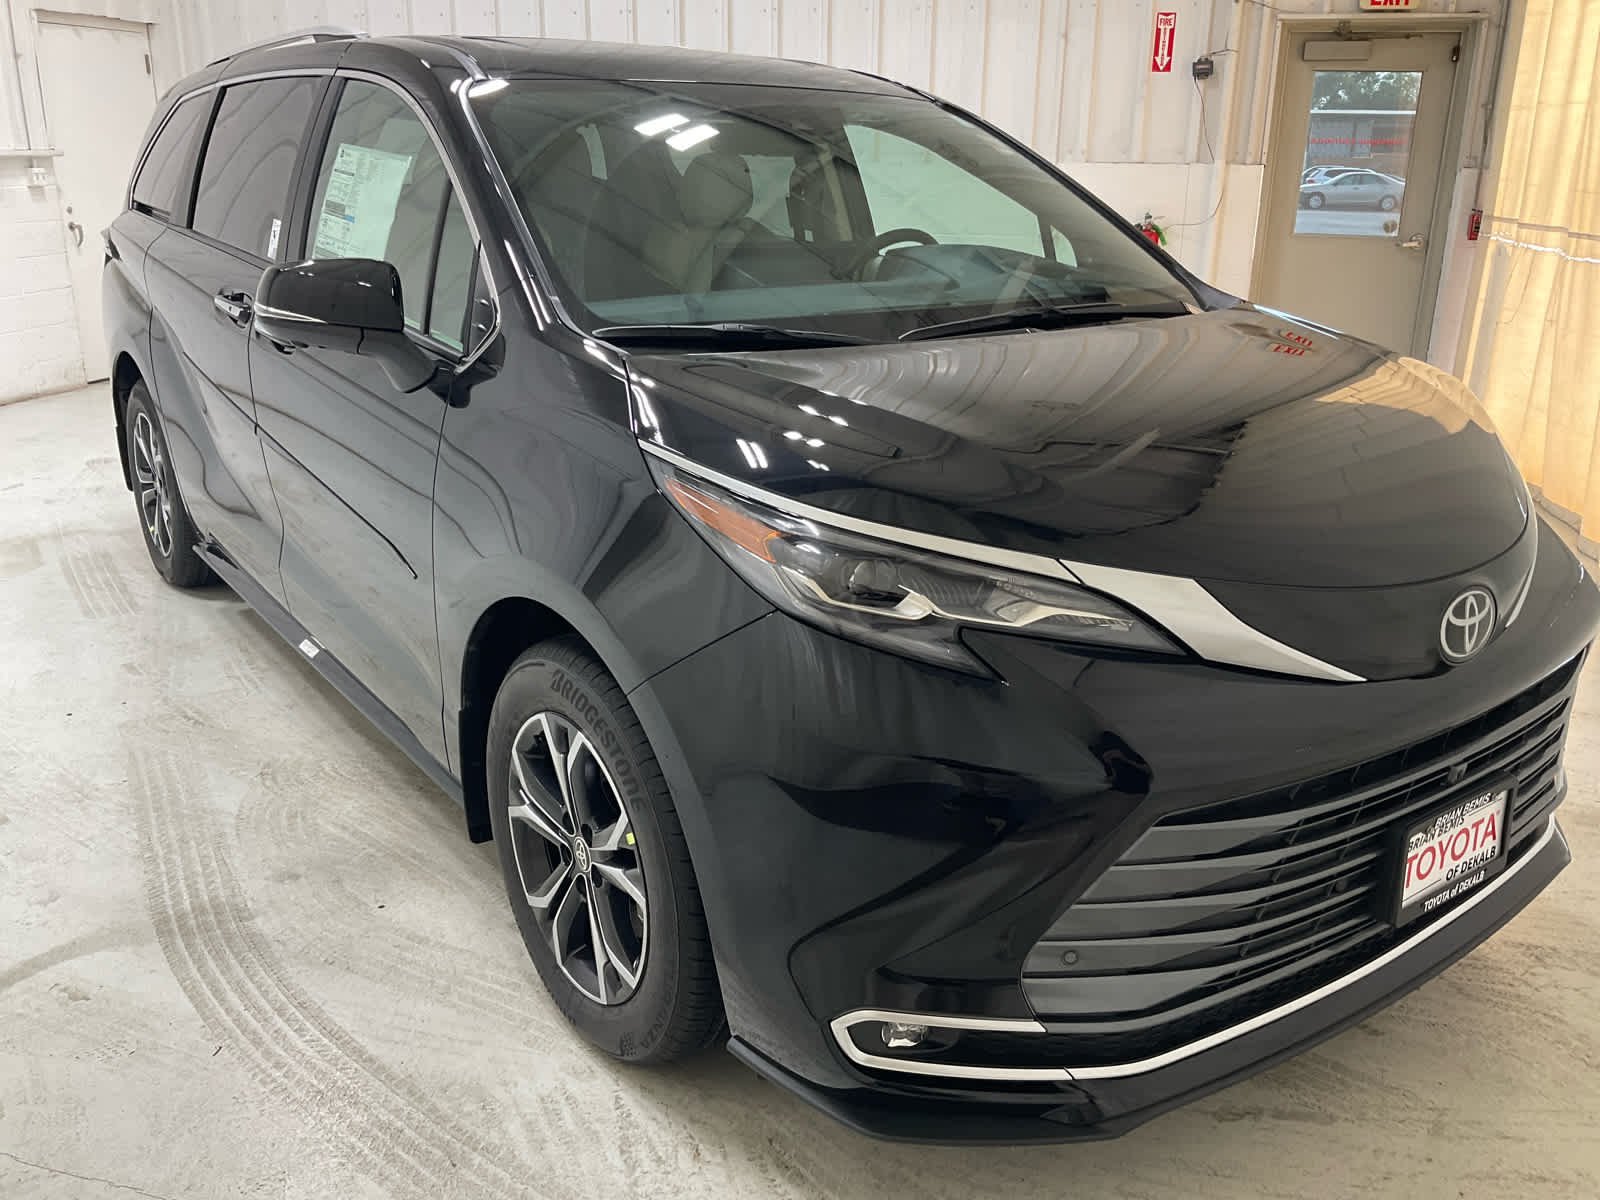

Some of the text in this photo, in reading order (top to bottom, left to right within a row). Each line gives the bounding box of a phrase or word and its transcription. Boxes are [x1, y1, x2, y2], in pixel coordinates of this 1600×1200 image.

[1159, 18, 1173, 27] FIRE
[1434, 792, 1492, 830] BRIAN BEMIS
[1406, 812, 1497, 889] TOYOTA
[1446, 845, 1497, 881] OF DEKALB
[1424, 868, 1486, 912] TOYOTA of DEKALB
